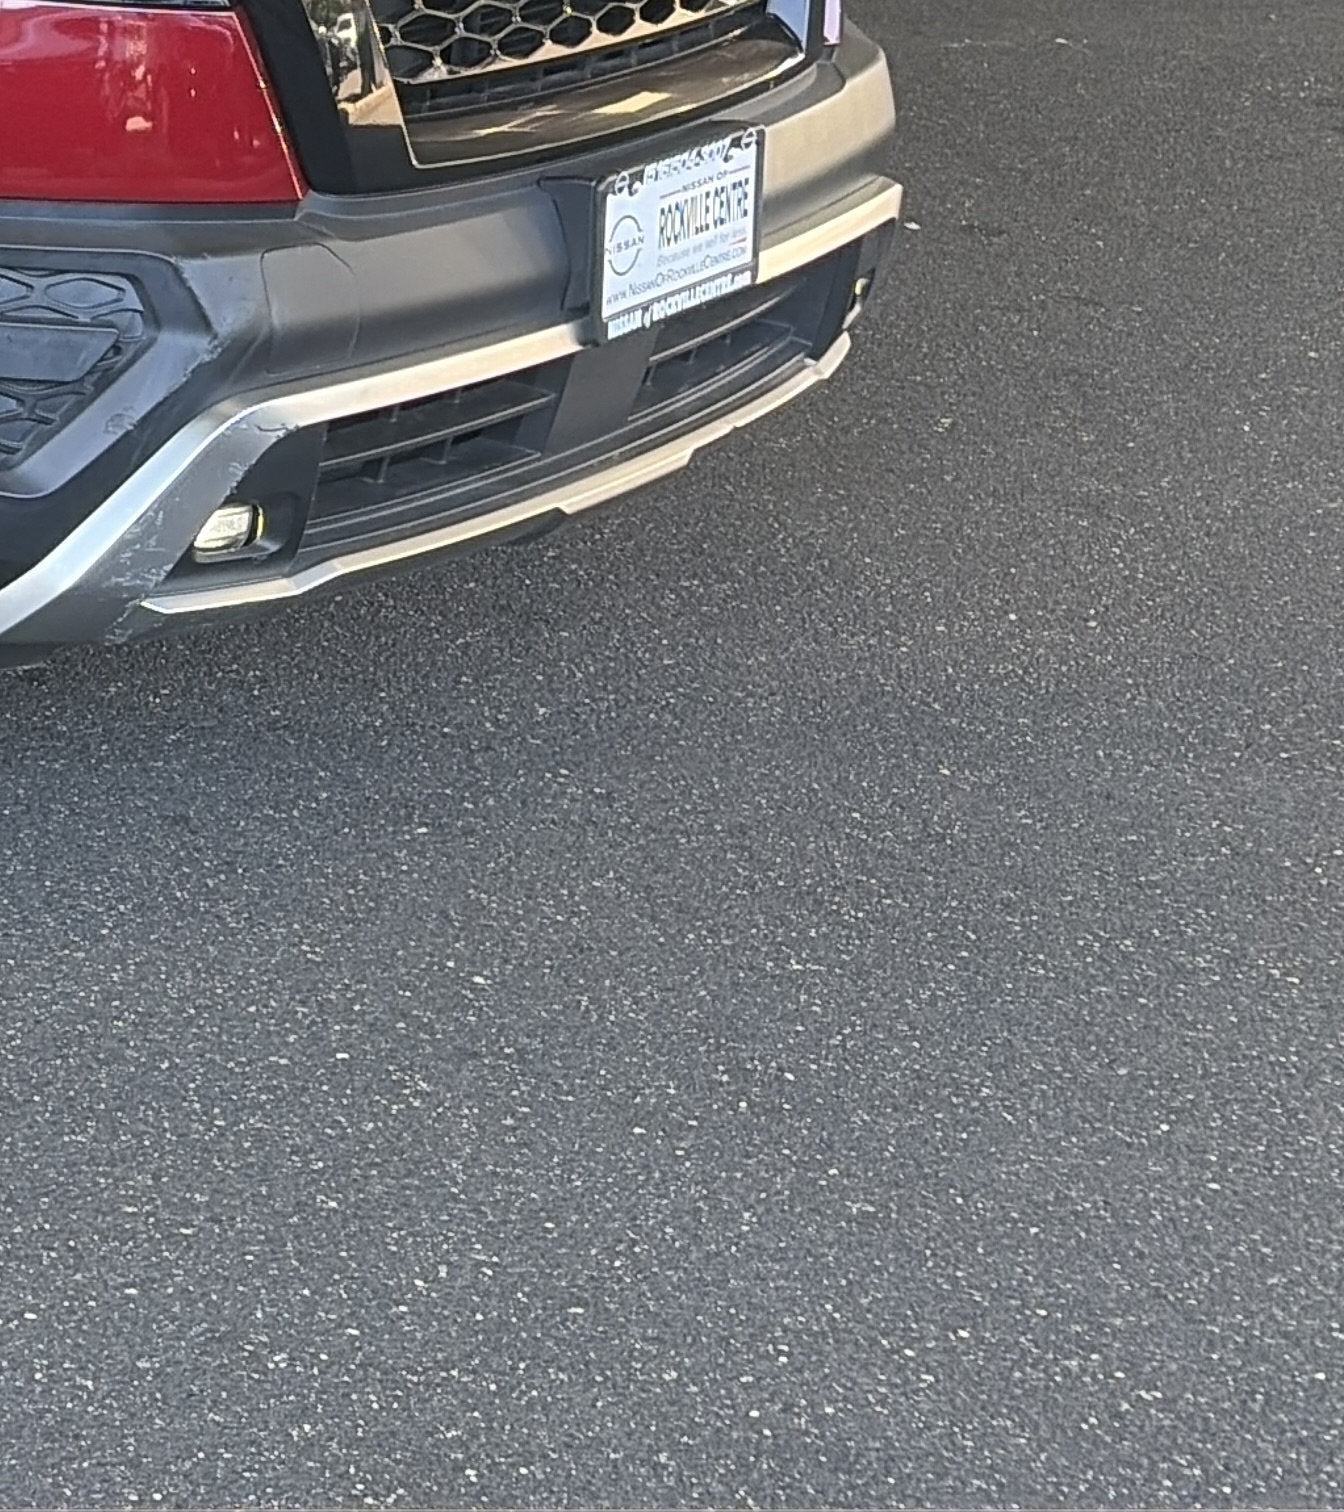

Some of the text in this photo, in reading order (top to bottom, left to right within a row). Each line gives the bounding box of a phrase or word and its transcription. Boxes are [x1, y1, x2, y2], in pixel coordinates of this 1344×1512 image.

[658, 177, 750, 250] ROCKVILLE CENTRE
[604, 235, 646, 256] NISSAN
